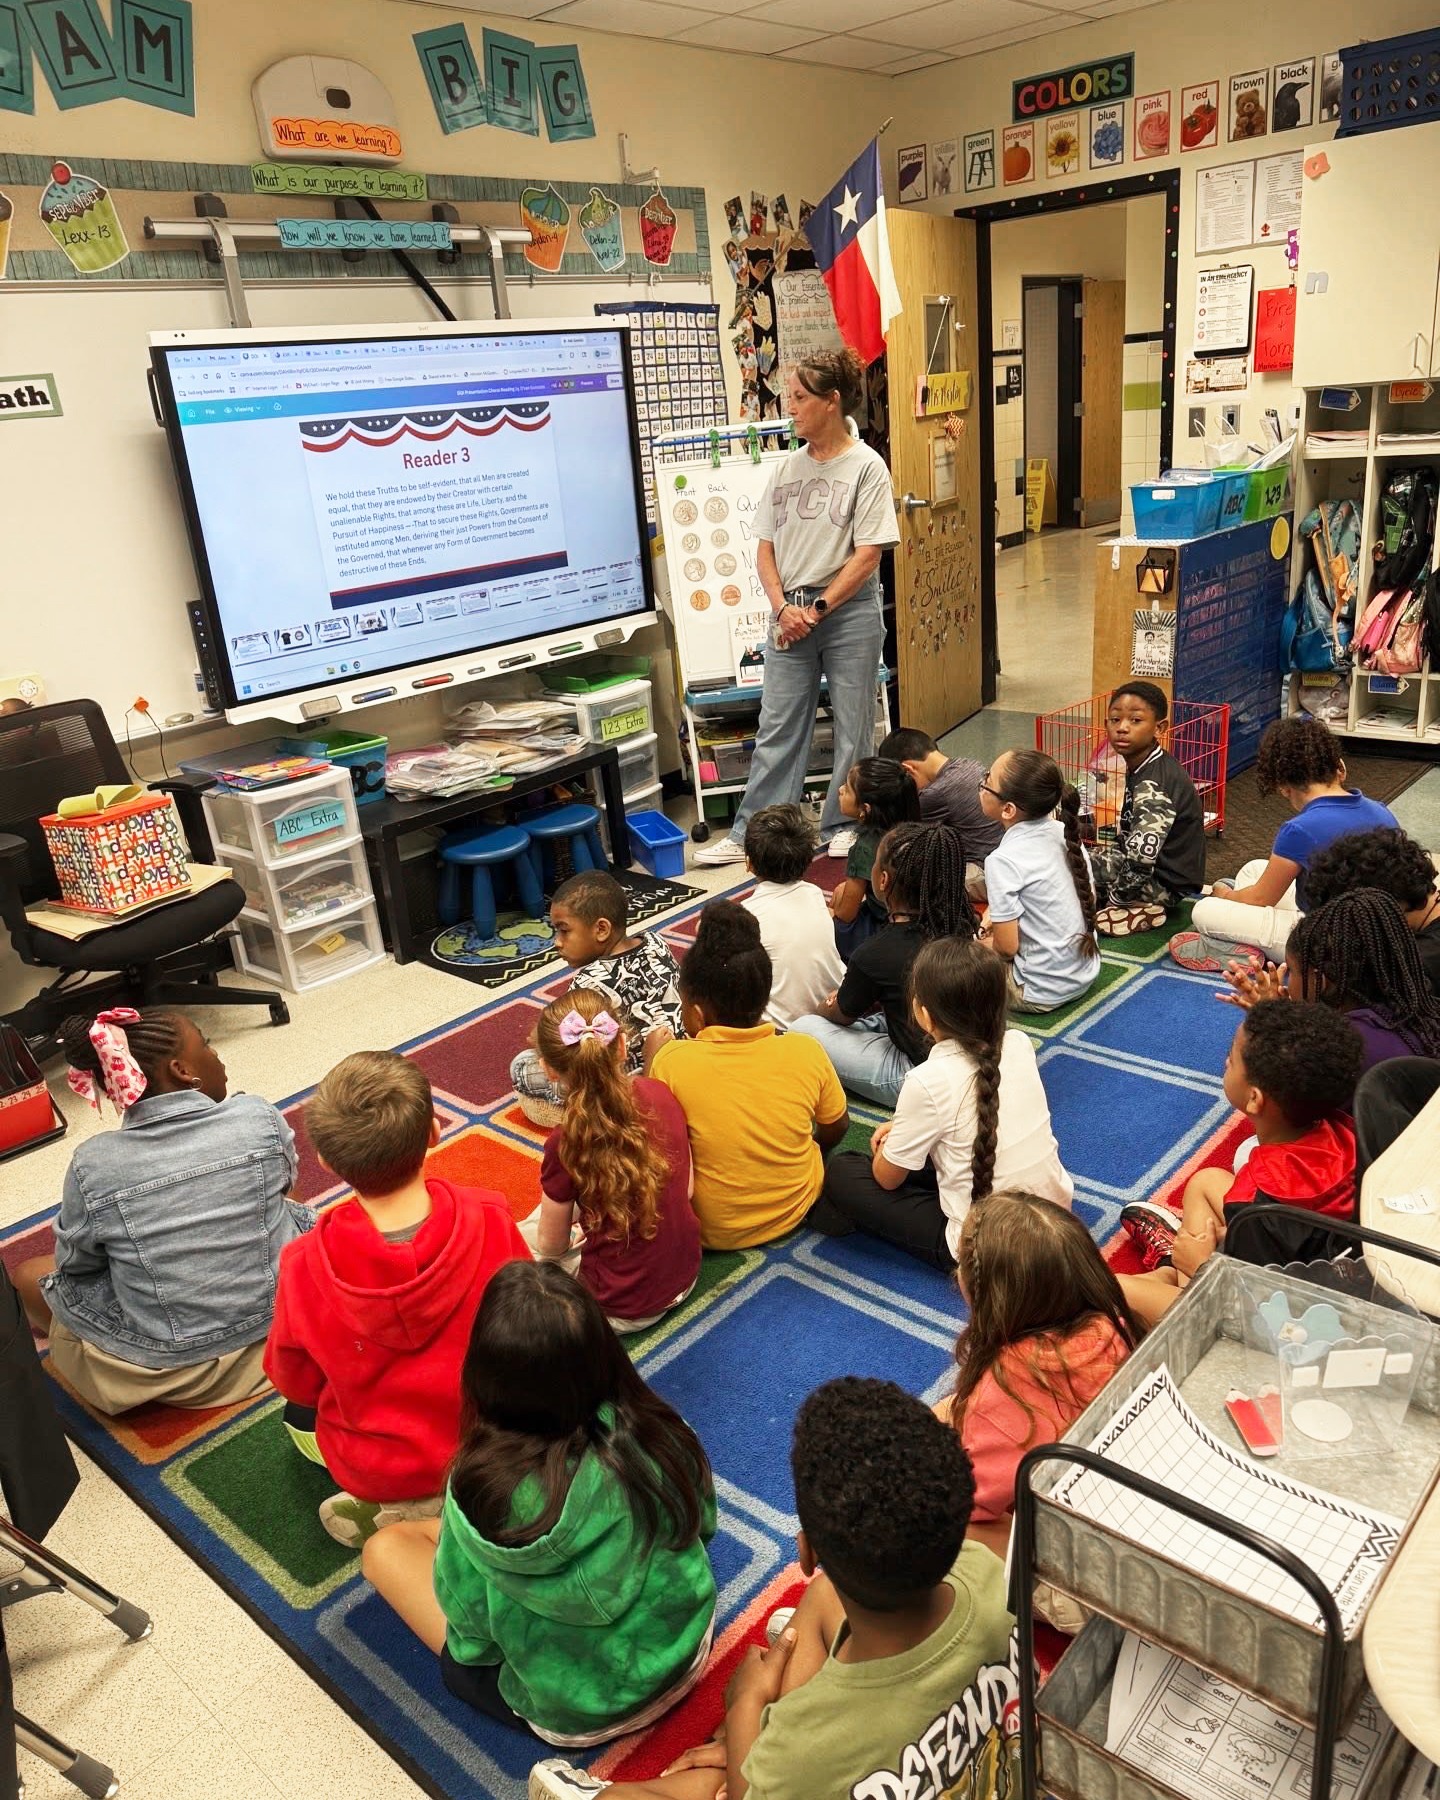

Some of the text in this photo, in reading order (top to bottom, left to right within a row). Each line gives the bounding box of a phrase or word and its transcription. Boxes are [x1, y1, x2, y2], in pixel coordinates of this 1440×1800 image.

[1280, 64, 1308, 80] black
[438, 55, 577, 117] BIG
[1018, 63, 1128, 114] COLORS
[1233, 75, 1265, 92] brown
[1192, 88, 1208, 101] red
[1142, 98, 1162, 113] pink
[1097, 110, 1117, 121] blue
[1005, 129, 1032, 141] orange
[1050, 118, 1076, 133] yellow
[276, 124, 393, 152] What are we learning?
[967, 136, 990, 150] green
[901, 150, 924, 164] purple
[252, 170, 424, 197] What is our purpose for learning it?
[279, 225, 299, 241] How
[306, 227, 321, 241] will
[326, 232, 337, 241] we
[341, 225, 366, 241] know
[373, 232, 385, 242] we
[389, 227, 407, 243] have
[410, 228, 437, 243] learned
[1215, 271, 1248, 280] EMERGENCY
[1266, 298, 1295, 317] Fire
[0, 385, 50, 409] ath
[234, 405, 254, 413] Viewing
[403, 447, 471, 469] Reader 3
[326, 493, 338, 501] We
[338, 491, 355, 500] hold
[356, 489, 376, 498] these
[376, 486, 399, 496] Truths
[408, 483, 417, 491] be
[459, 476, 472, 485] that
[473, 475, 481, 483] all
[482, 474, 495, 482] Men
[496, 472, 506, 480] are
[507, 469, 530, 479] created
[675, 487, 696, 496] Front
[708, 483, 728, 492] Back
[328, 483, 513, 515] equal, that they are endowed by their Creator with certain
[1224, 493, 1245, 515] ABC
[1265, 485, 1282, 505] 123
[330, 515, 372, 527] unalienable
[398, 508, 412, 517] that
[413, 506, 436, 515] among
[436, 503, 455, 512] these
[455, 501, 466, 509] are
[505, 494, 517, 502] and
[517, 493, 527, 501] the
[773, 478, 855, 532] TCU
[332, 529, 359, 540] Pursuit
[359, 528, 367, 536] of
[437, 515, 459, 525] secure
[460, 513, 478, 522] these
[500, 504, 539, 515] Governments
[370, 538, 394, 547] among
[412, 529, 439, 540] deriving
[440, 526, 455, 535] their
[456, 525, 468, 535] just
[468, 521, 492, 532] Powers
[492, 519, 507, 528] from
[507, 517, 517, 525] the
[518, 514, 542, 524] Consent
[337, 527, 535, 565] the Governed, that whenever any Form of Government becomes
[339, 559, 407, 577] destructive of these
[604, 715, 644, 735] 123 Extra
[350, 761, 386, 797] BC
[279, 809, 339, 837] ABC Extra
[21, 1091, 32, 1099] 24
[36, 1085, 45, 1094] 25
[9, 1097, 19, 1106] 23
[1340, 1569, 1368, 1606] can write
[1185, 1737, 1208, 1753] droc
